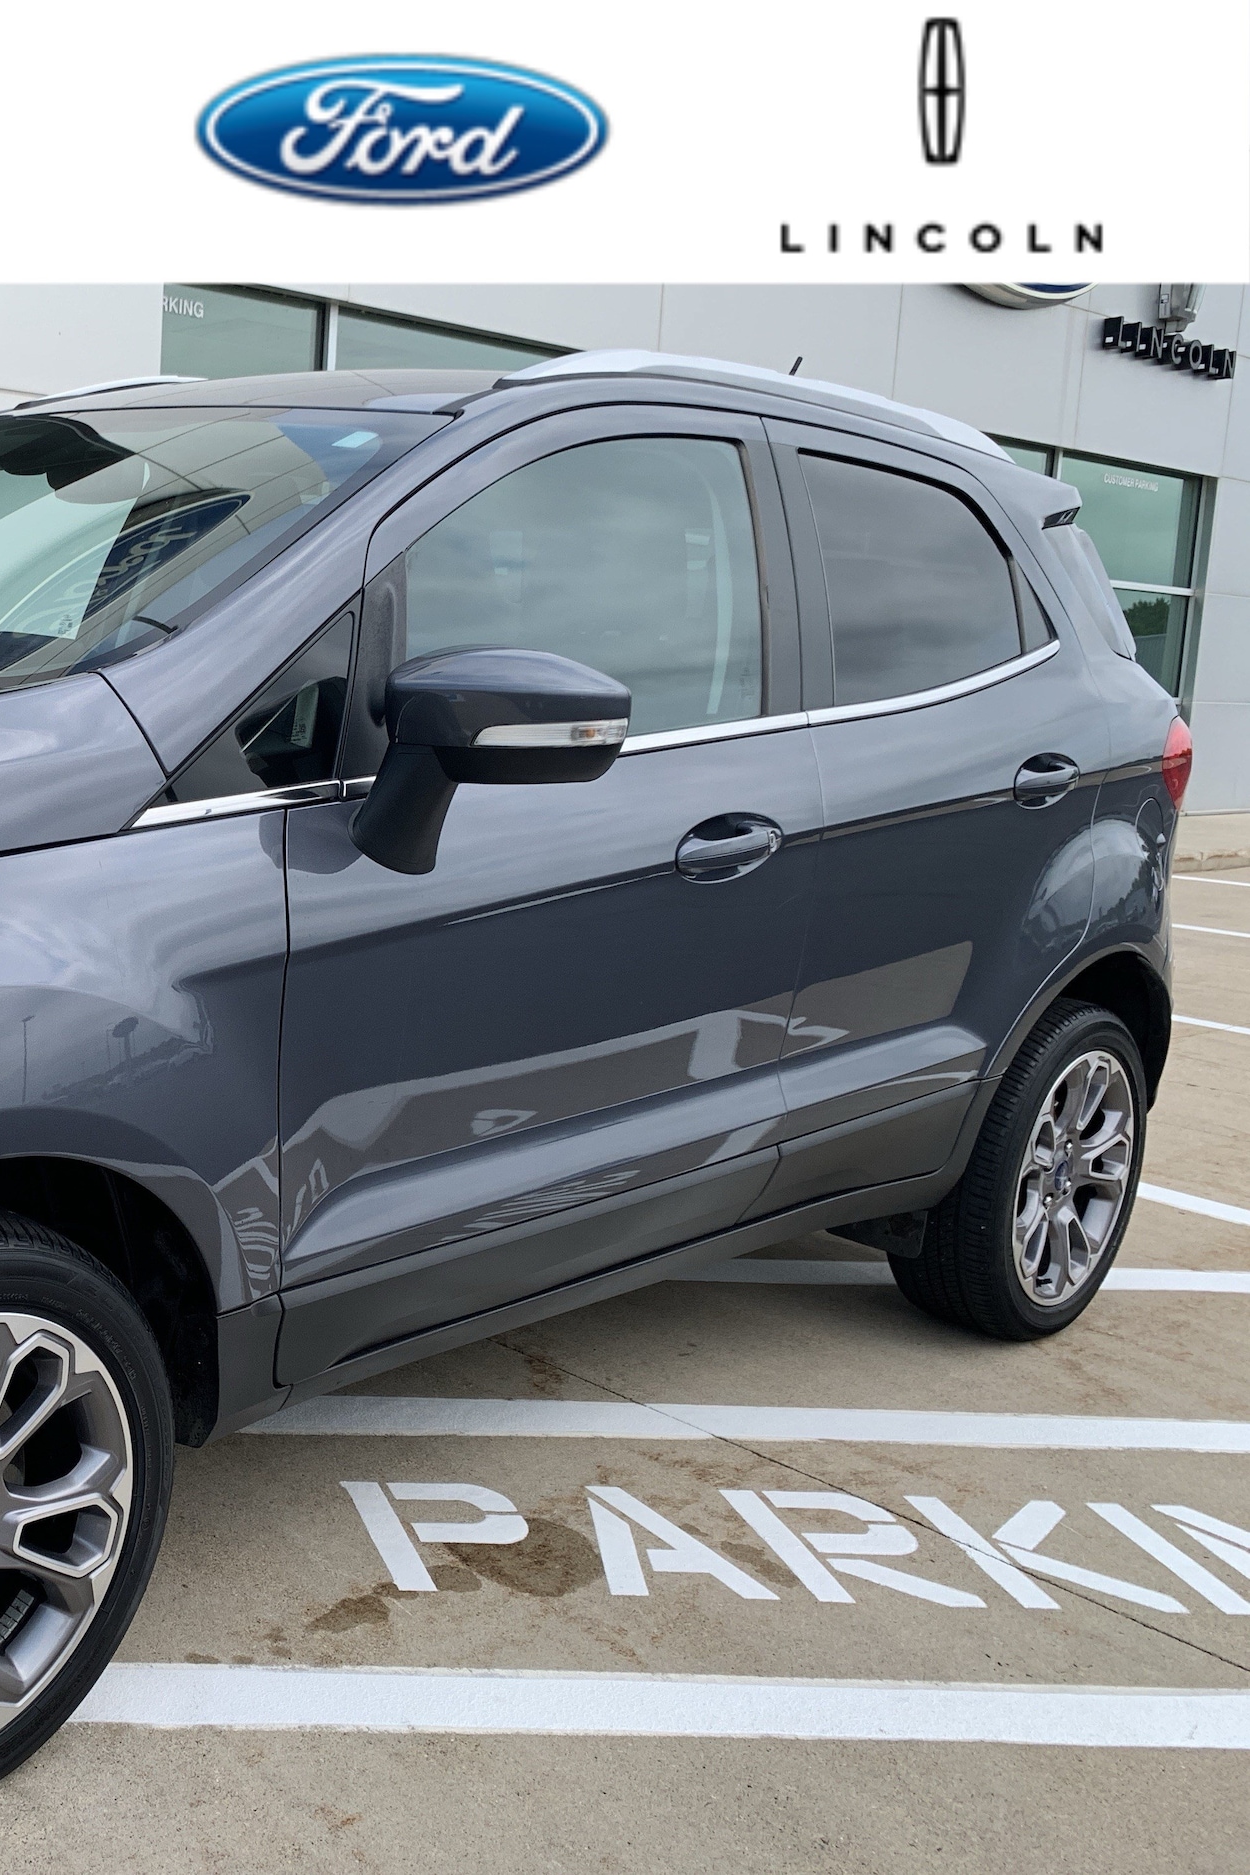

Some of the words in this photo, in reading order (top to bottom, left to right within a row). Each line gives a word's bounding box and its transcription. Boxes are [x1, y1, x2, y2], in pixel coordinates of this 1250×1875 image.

[1108, 316, 1236, 379] LINCOLN
[1104, 473, 1135, 488] CUSTOMER
[1135, 478, 1159, 492] PARKING
